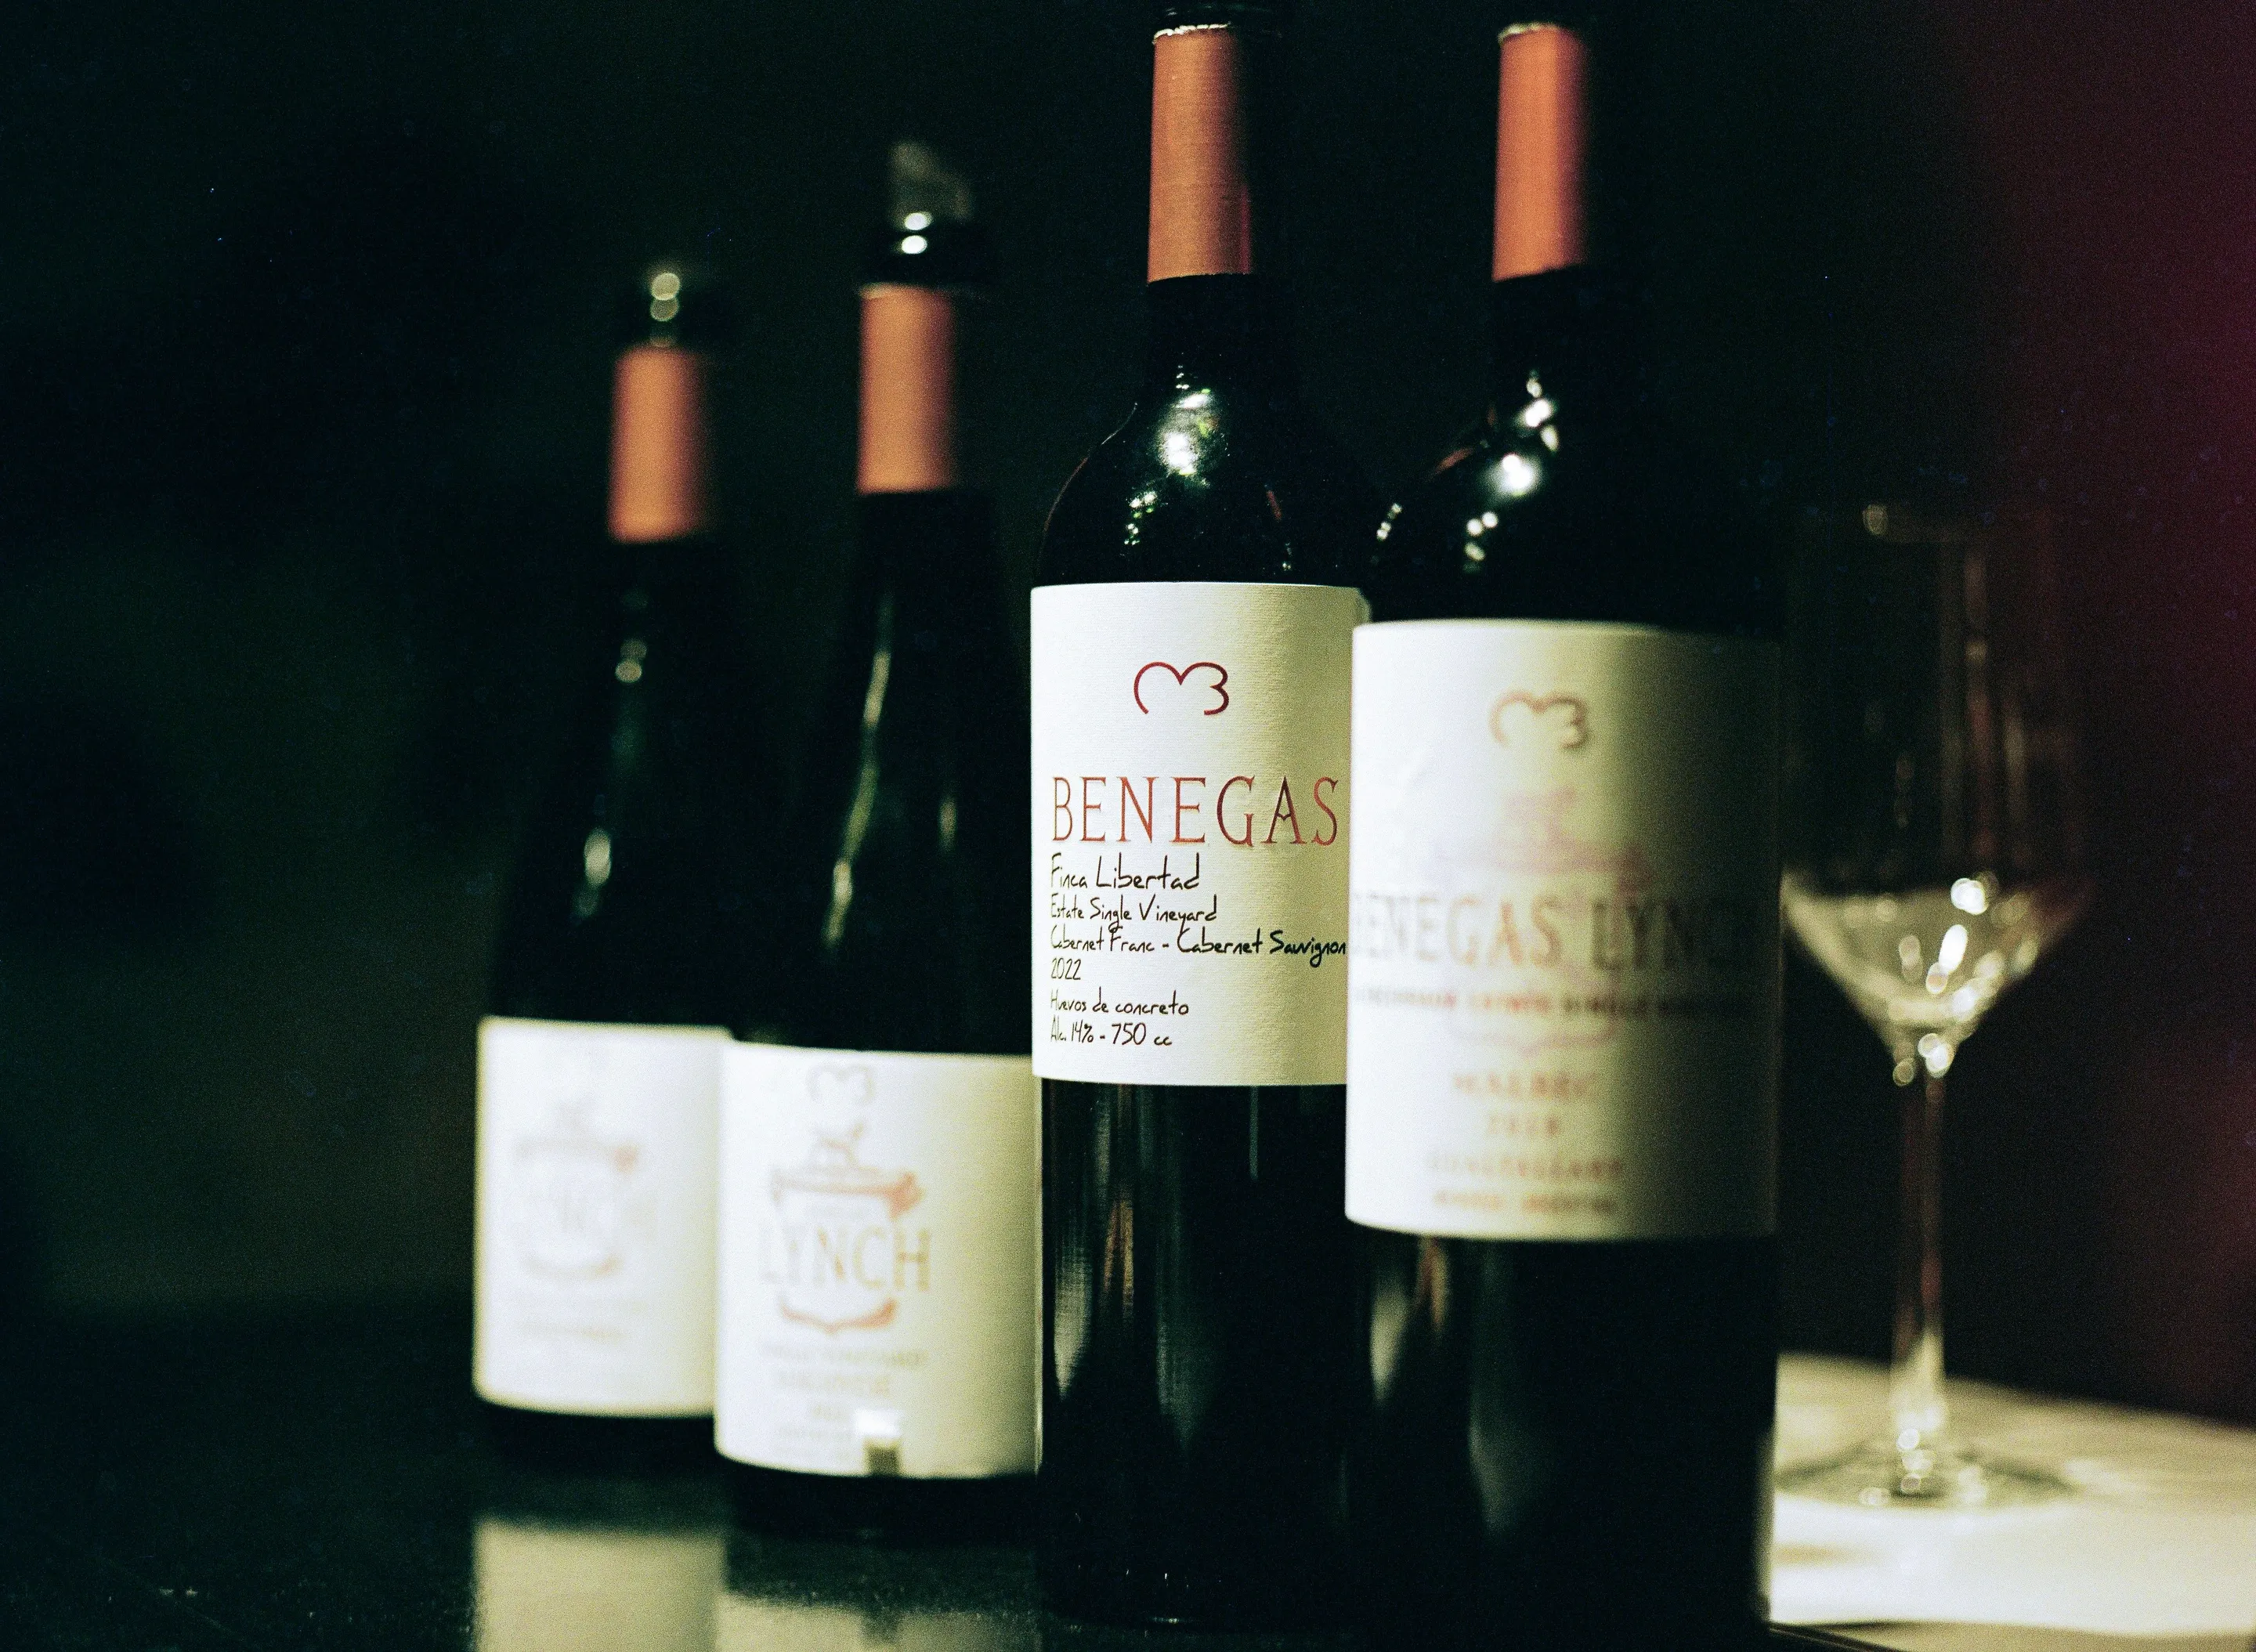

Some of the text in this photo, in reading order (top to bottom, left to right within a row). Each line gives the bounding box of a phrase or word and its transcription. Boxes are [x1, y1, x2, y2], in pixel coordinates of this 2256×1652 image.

[1051, 775, 1340, 847] BENEGAS
[1050, 851, 1200, 890] Finca Libertad
[1050, 892, 1217, 933] Estate Single Vineyard
[1353, 890, 1562, 970] ENEGAS
[1050, 923, 1104, 952] Cabernet
[1108, 925, 1155, 953] Franc
[1177, 926, 1264, 954] Cabernet
[1269, 929, 1347, 968] Sauvignon
[1050, 957, 1082, 980] 2022
[1050, 985, 1189, 1015] Huevos de concreto
[1050, 1014, 1067, 1043] Alc.
[1071, 1019, 1094, 1043] 14%
[1112, 1021, 1147, 1046] 750
[1153, 1035, 1173, 1047] cc
[760, 1220, 932, 1292] LYNCH
